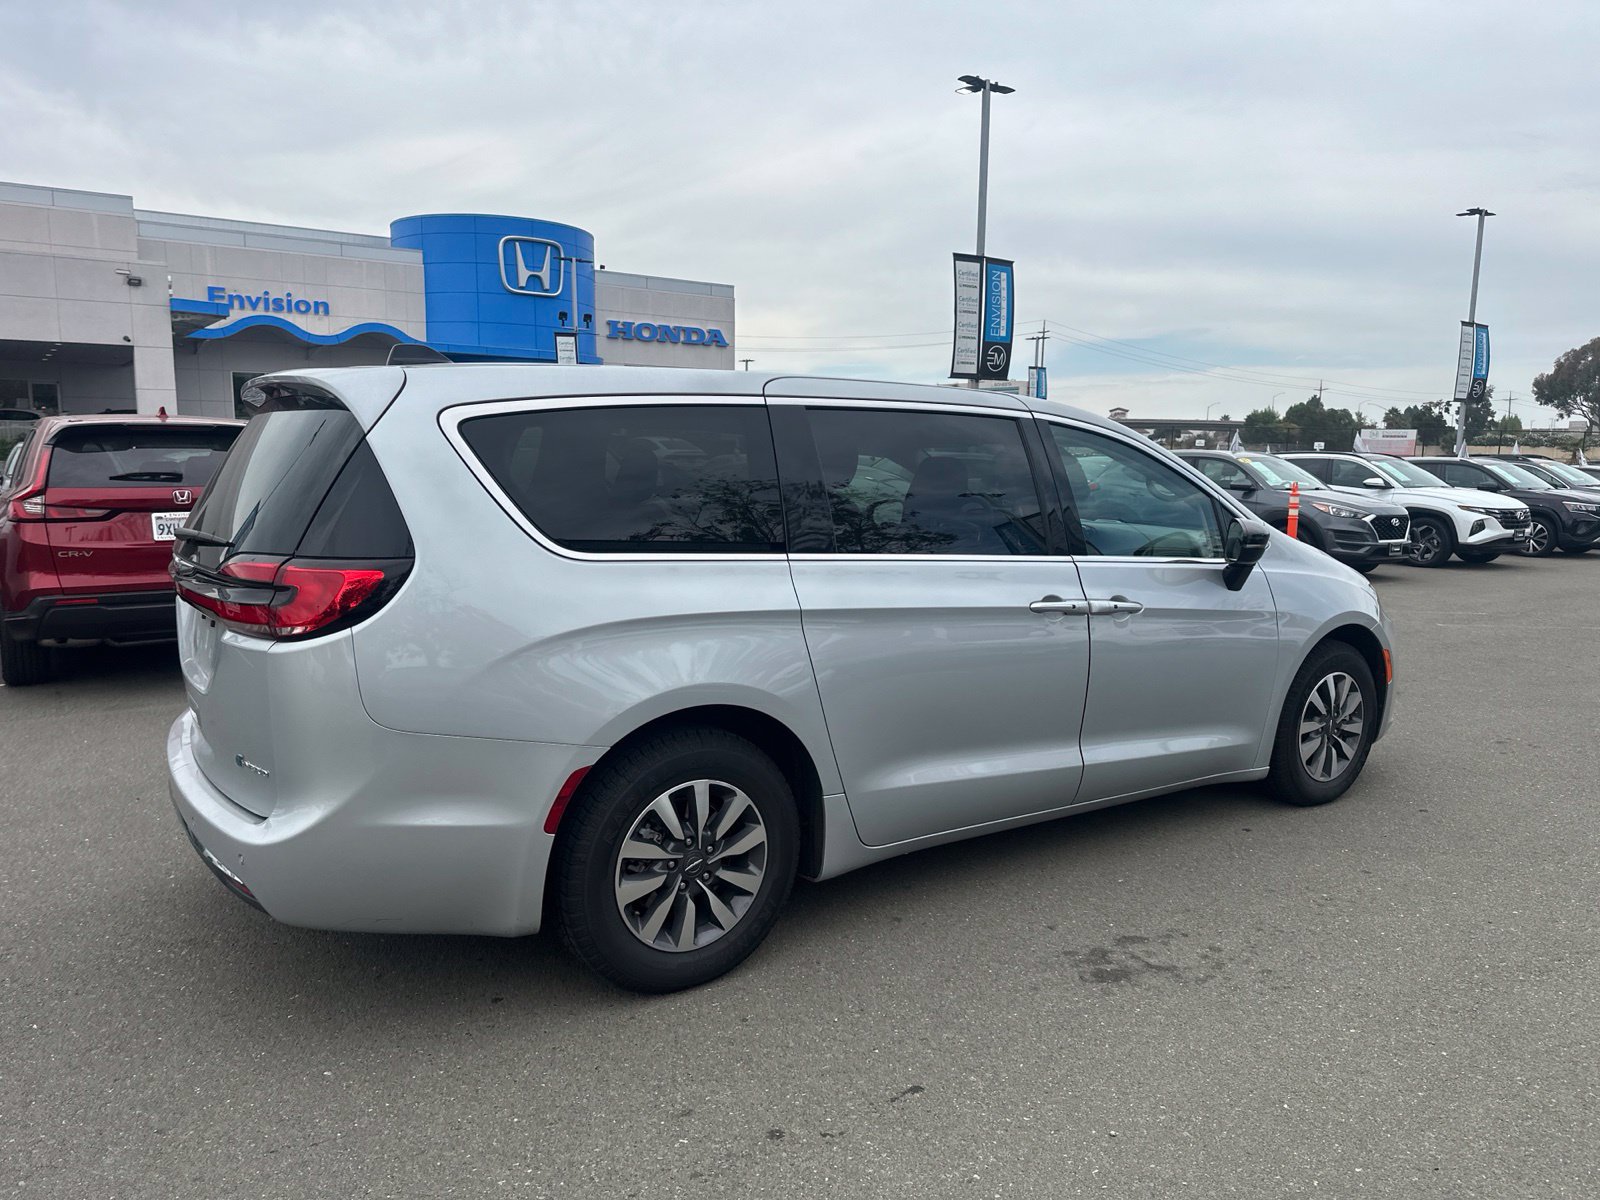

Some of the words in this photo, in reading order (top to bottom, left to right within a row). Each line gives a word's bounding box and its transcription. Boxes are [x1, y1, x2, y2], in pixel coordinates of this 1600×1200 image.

[207, 286, 329, 316] Envision
[991, 270, 1001, 336] ENVISION
[606, 319, 729, 347] HONDA
[58, 550, 93, 558] CR-V
